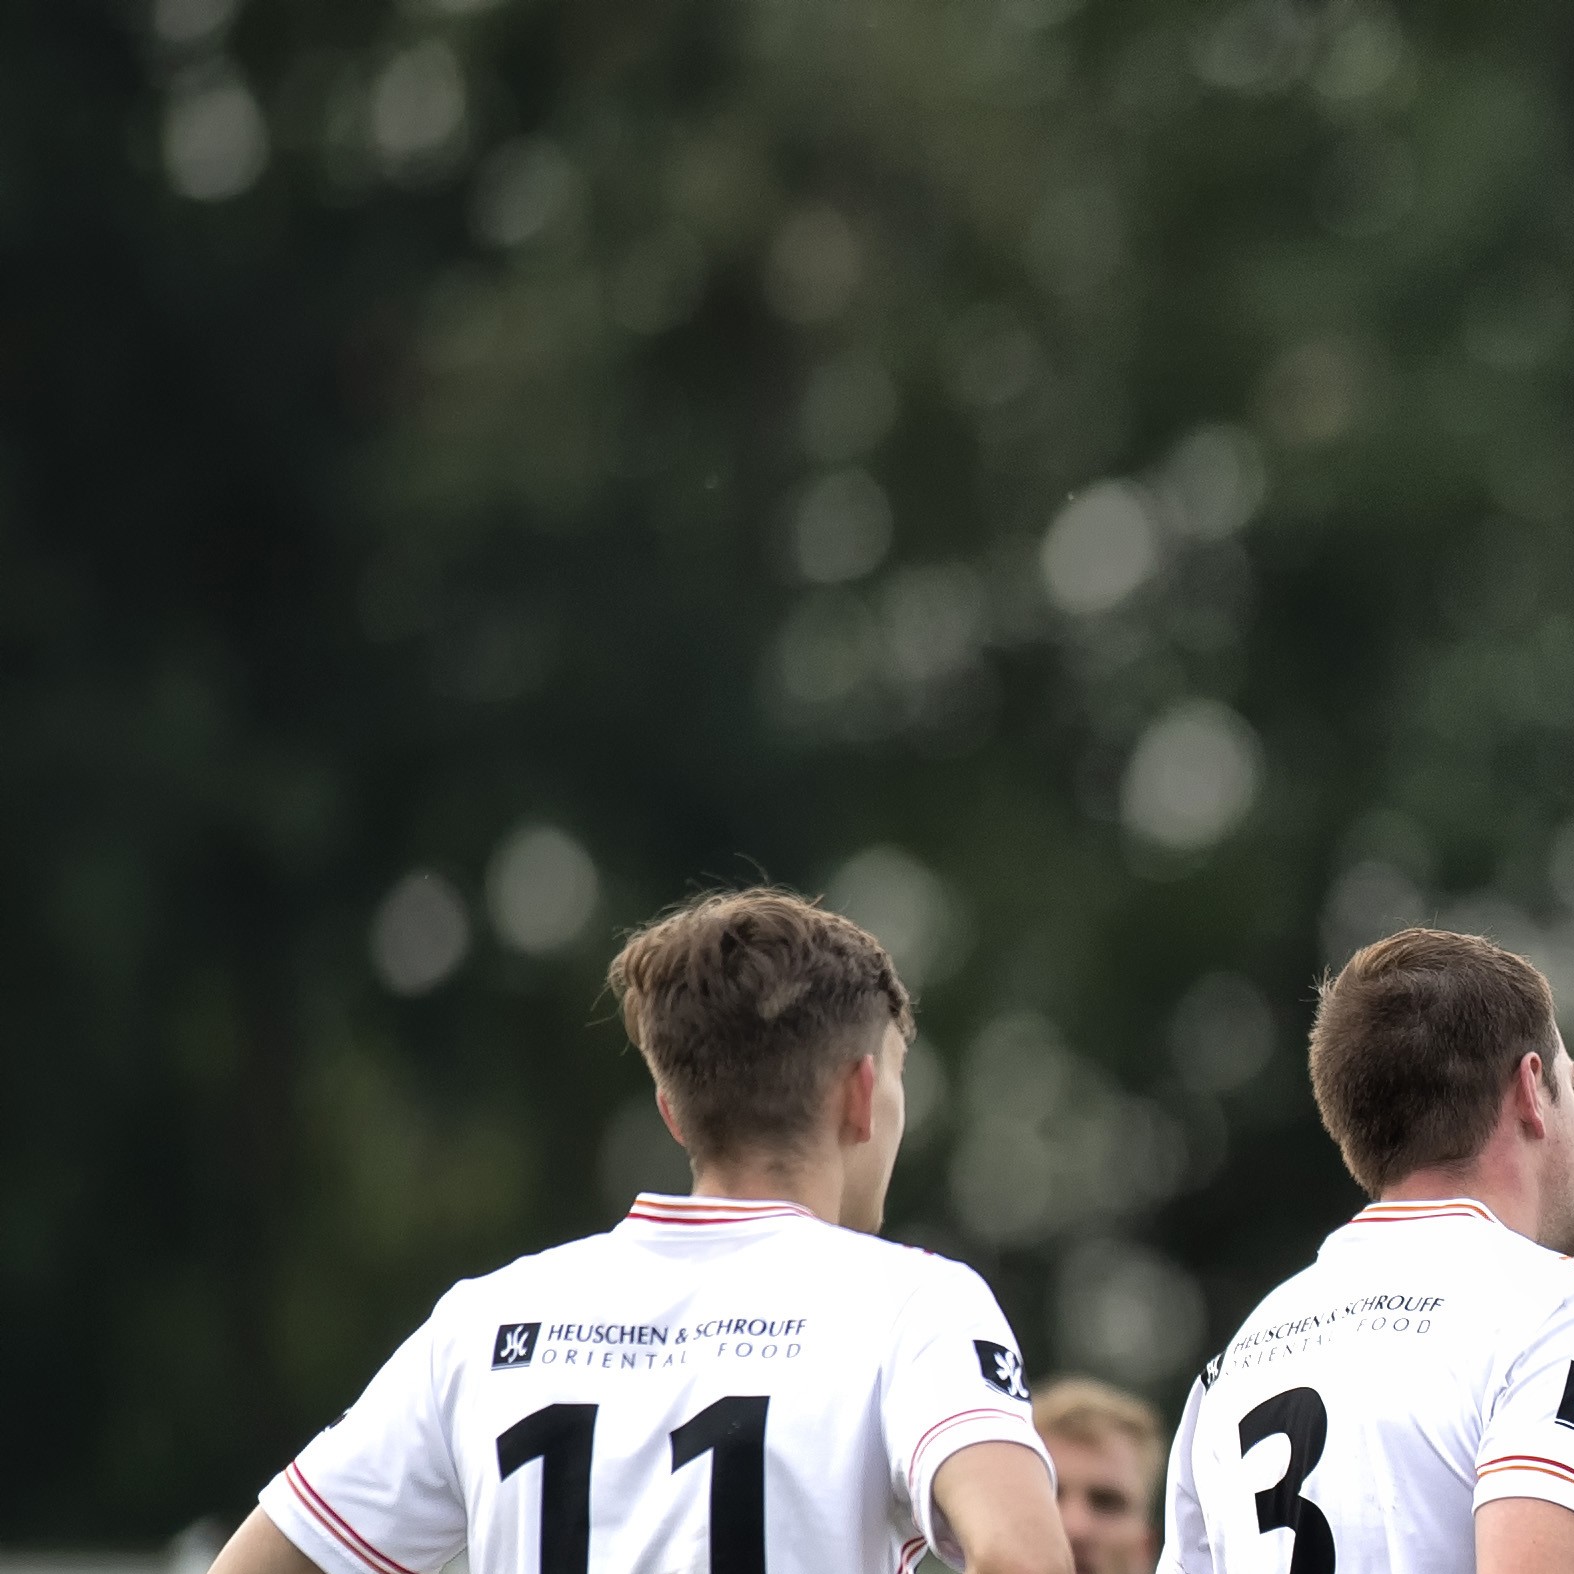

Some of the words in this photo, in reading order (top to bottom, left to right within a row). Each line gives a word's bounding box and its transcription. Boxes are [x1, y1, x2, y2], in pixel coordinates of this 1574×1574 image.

[546, 1322, 669, 1346] HEUSCHEN
[674, 1327, 688, 1345] &
[693, 1318, 807, 1341] SCHROUFF
[1232, 1312, 1326, 1355] HEUSCHEN
[1341, 1294, 1444, 1319] SCHROUFF
[1356, 1316, 1431, 1334] FOOD
[540, 1348, 687, 1370] ORIENTAL
[716, 1342, 802, 1359] FOOD
